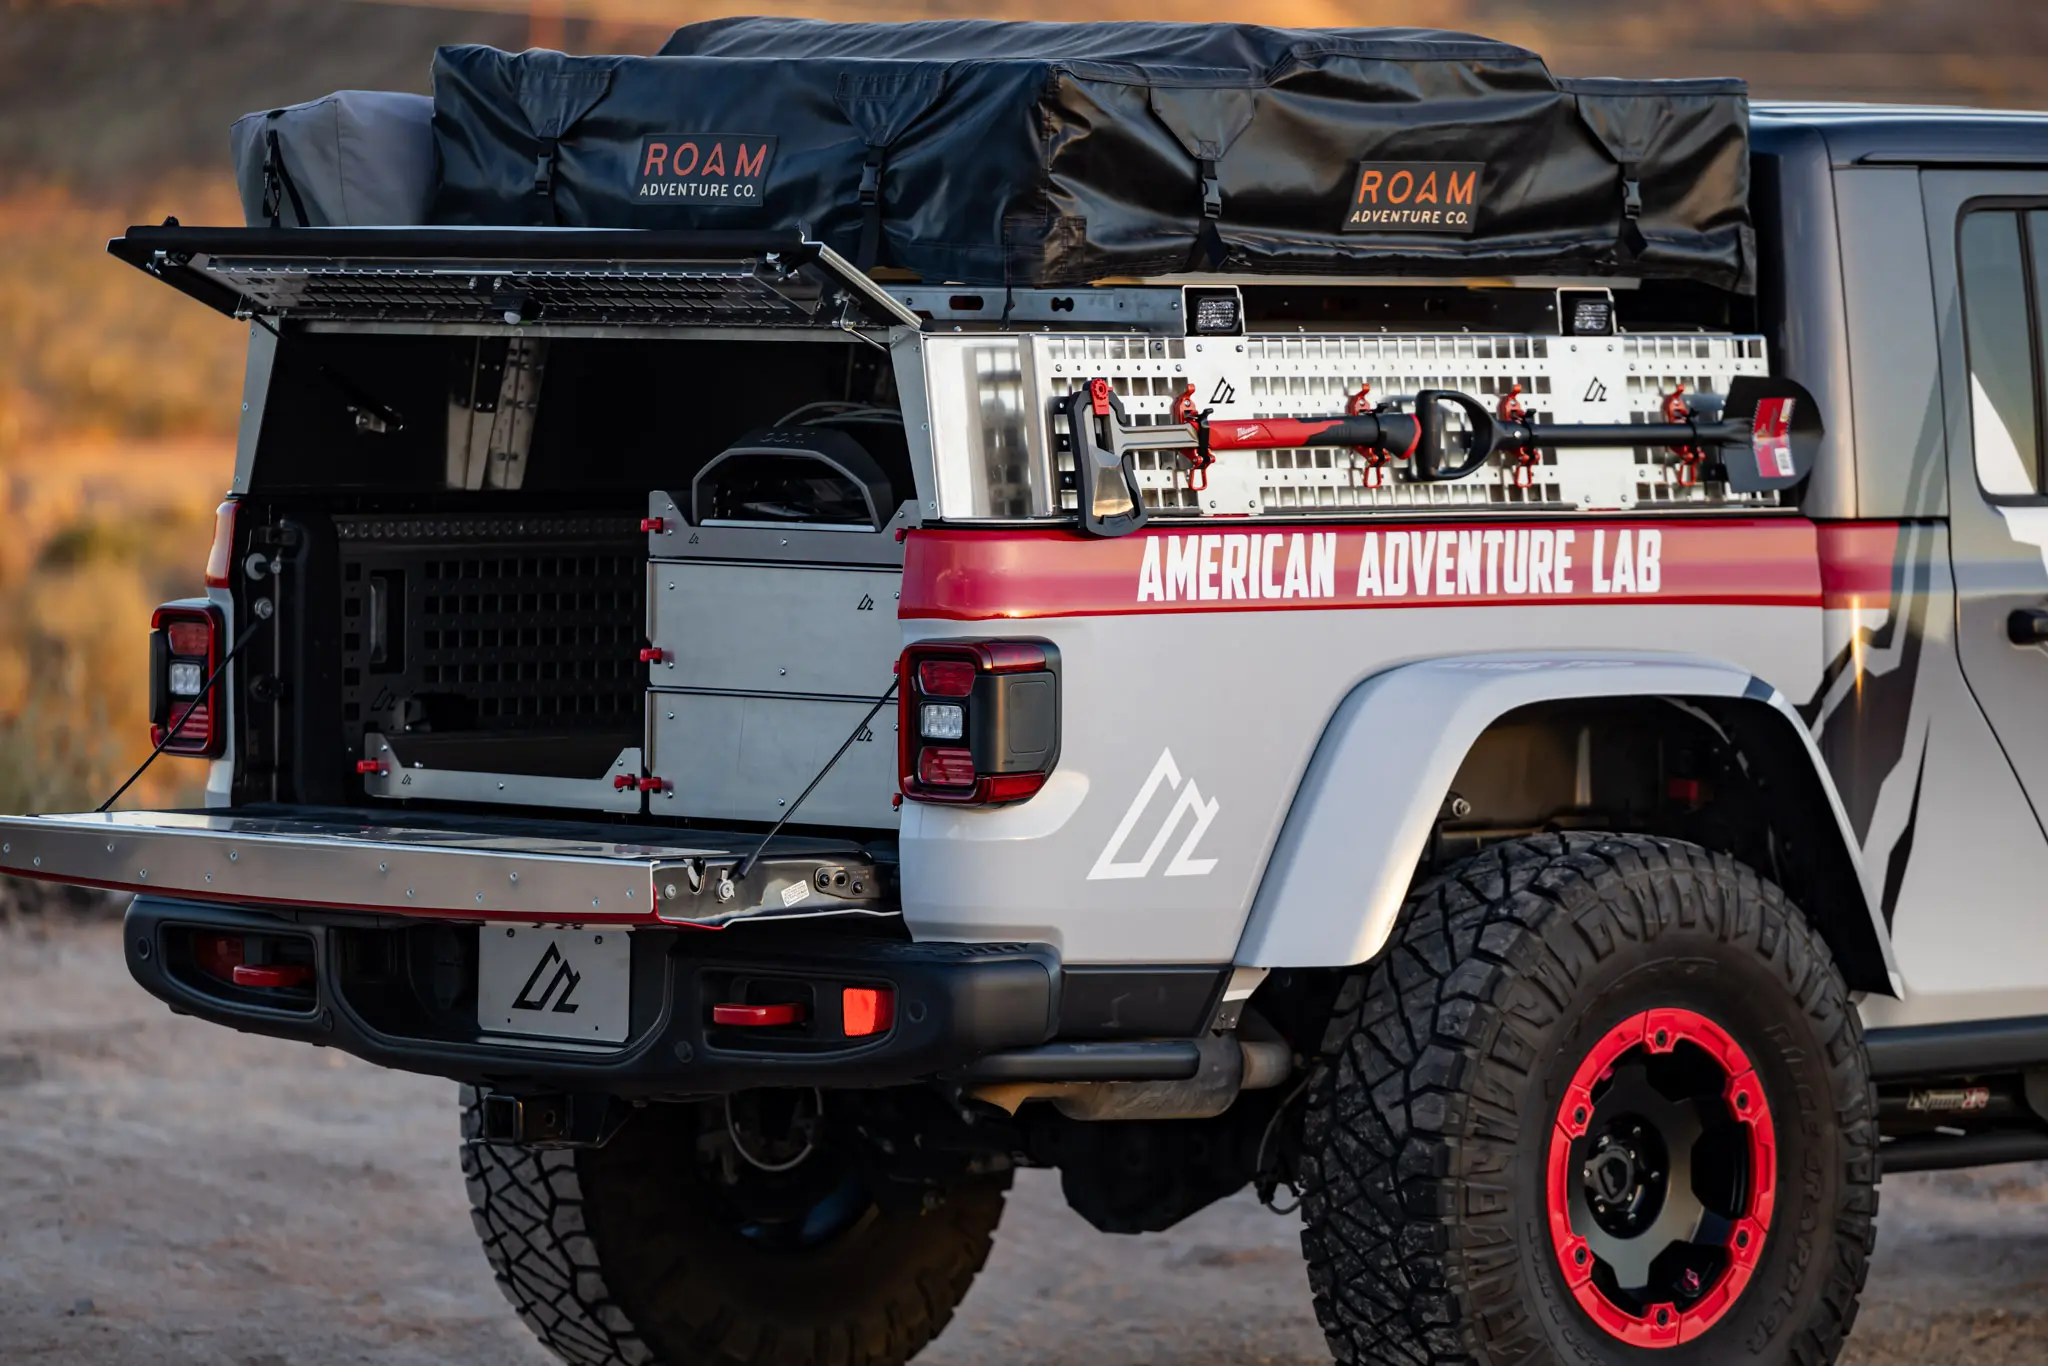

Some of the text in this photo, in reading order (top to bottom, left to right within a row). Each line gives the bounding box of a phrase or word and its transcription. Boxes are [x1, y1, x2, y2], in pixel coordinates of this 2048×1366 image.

[643, 142, 768, 177] ROAM
[639, 183, 756, 197] ADVENTURE CO.
[1358, 170, 1476, 205] ROAM
[1350, 209, 1469, 225] ADVENTURE CO.
[1137, 529, 1662, 602] AMERICAN ADVENTURE LAB
